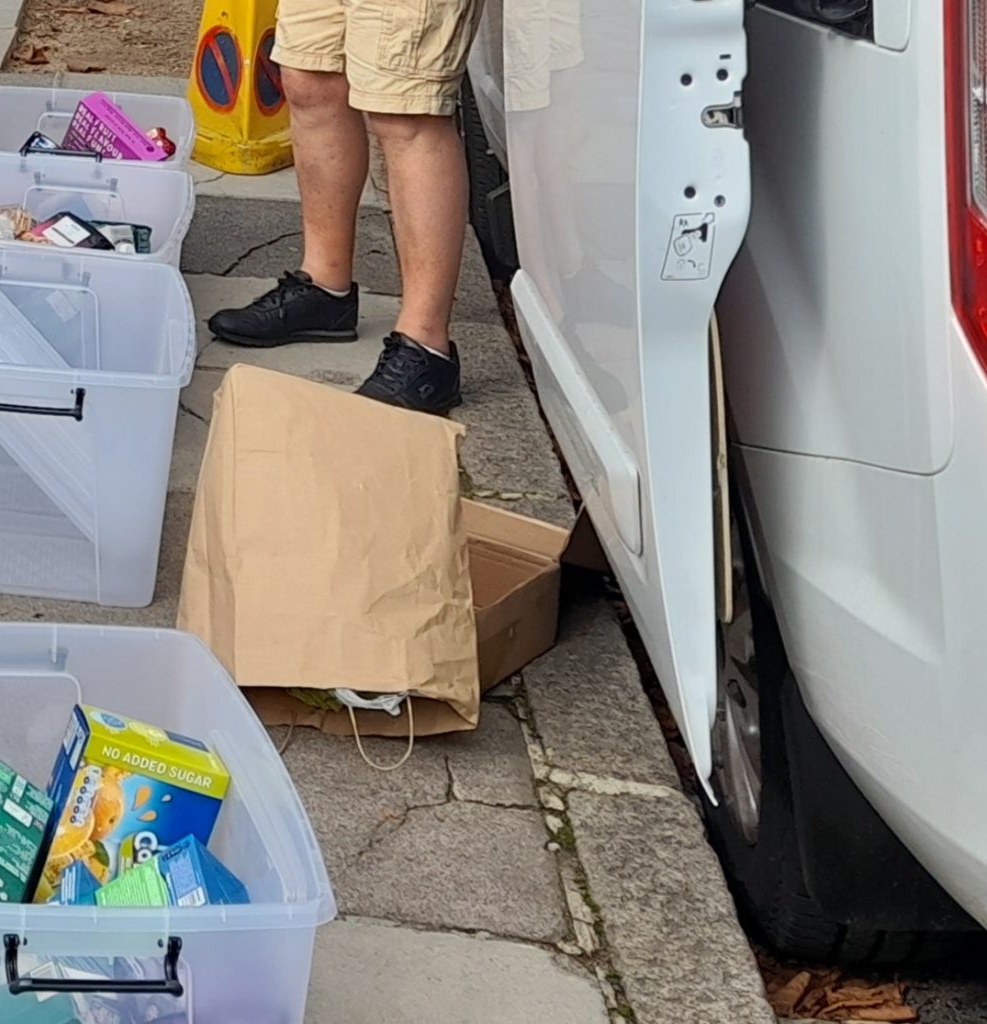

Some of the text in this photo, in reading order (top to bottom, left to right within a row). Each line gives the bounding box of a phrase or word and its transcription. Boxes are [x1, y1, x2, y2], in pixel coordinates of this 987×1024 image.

[72, 119, 87, 138] REAL
[74, 112, 92, 132] REAL
[90, 124, 124, 161] FLAVOUR
[77, 103, 95, 123] REAL
[94, 118, 118, 143] FRUIT
[101, 745, 213, 789] NO ADDED SUGAR
